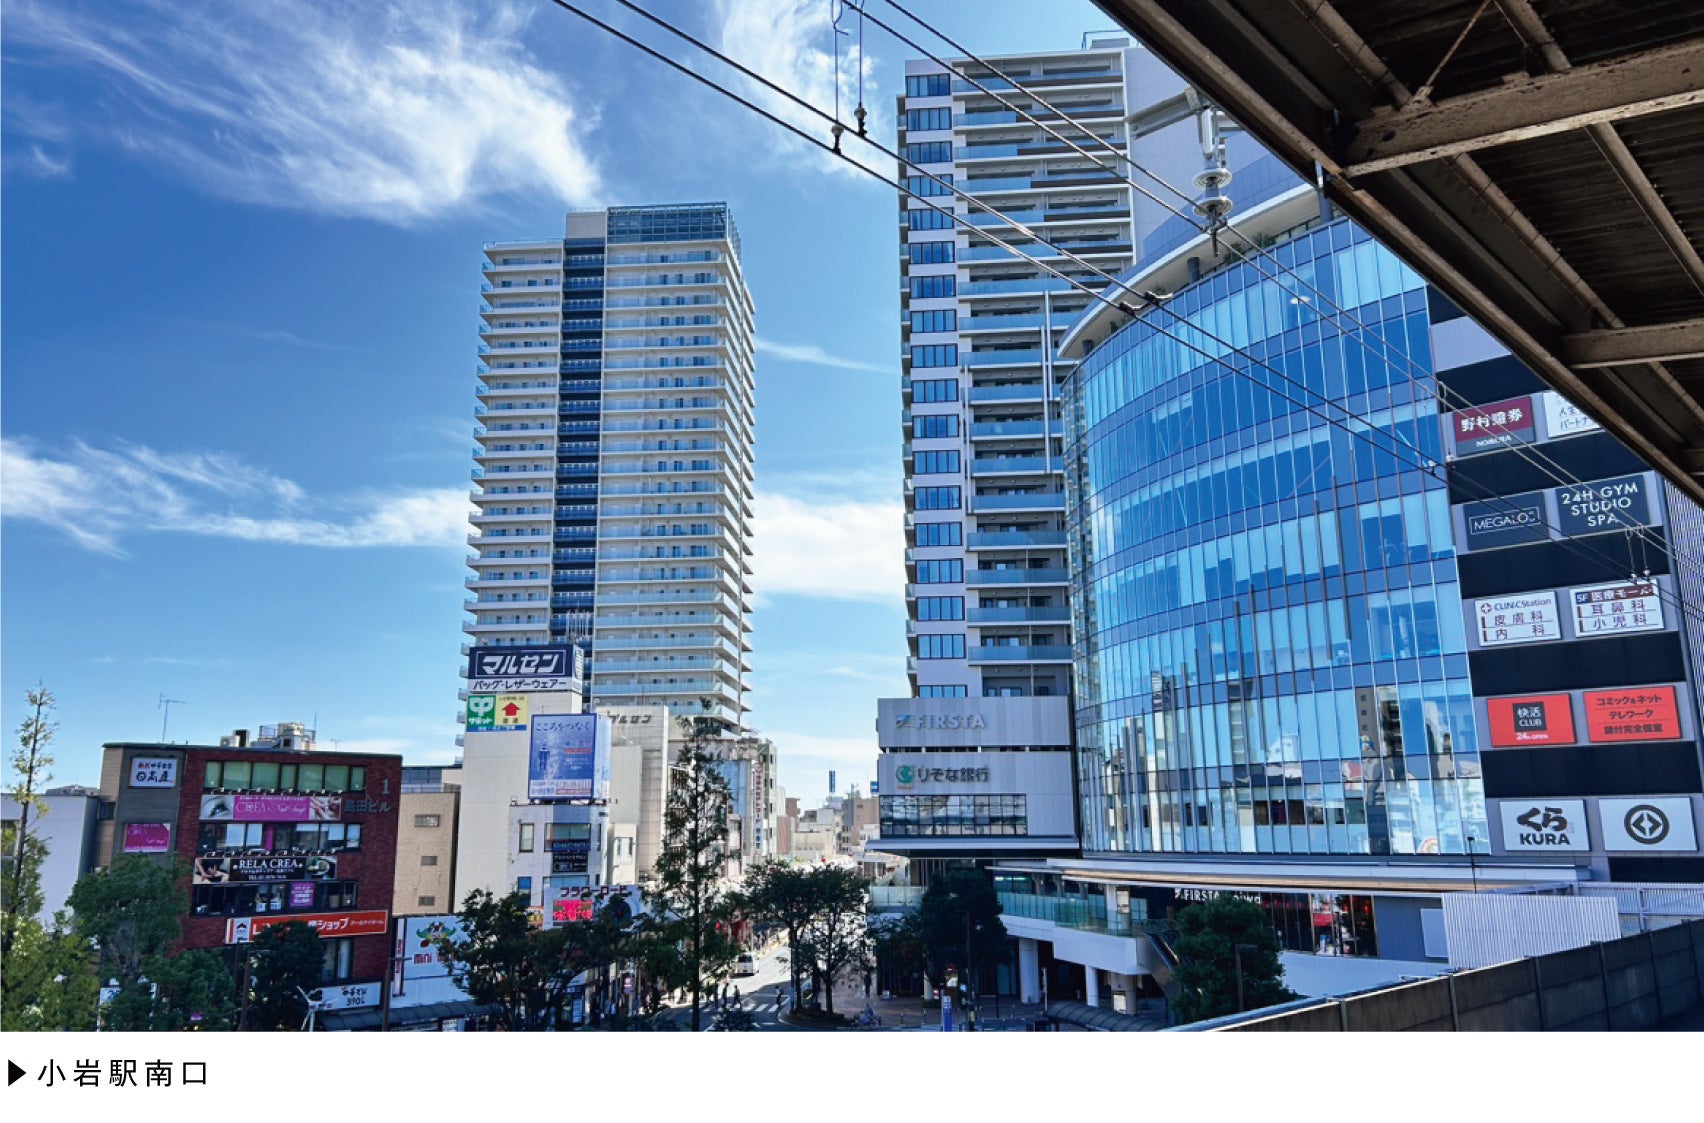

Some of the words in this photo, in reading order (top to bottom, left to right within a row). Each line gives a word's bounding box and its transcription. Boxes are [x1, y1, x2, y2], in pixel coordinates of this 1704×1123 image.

[1476, 435, 1512, 448] NOMURA
[1561, 490, 1593, 505] 24H
[1601, 482, 1638, 497] GYM
[1571, 497, 1631, 516] STUDIO
[1474, 511, 1537, 530] MEGALOS
[1588, 513, 1619, 528] SPA
[1593, 613, 1646, 629] 小児科
[916, 714, 985, 729] FIRSTA
[1609, 709, 1653, 719] テレワーク
[1518, 718, 1542, 727] CLUB
[918, 767, 989, 782] りそな銀行
[1517, 807, 1567, 831] くら
[1520, 833, 1570, 845] KURA
[239, 859, 268, 869] RELA
[269, 858, 297, 868] CREA
